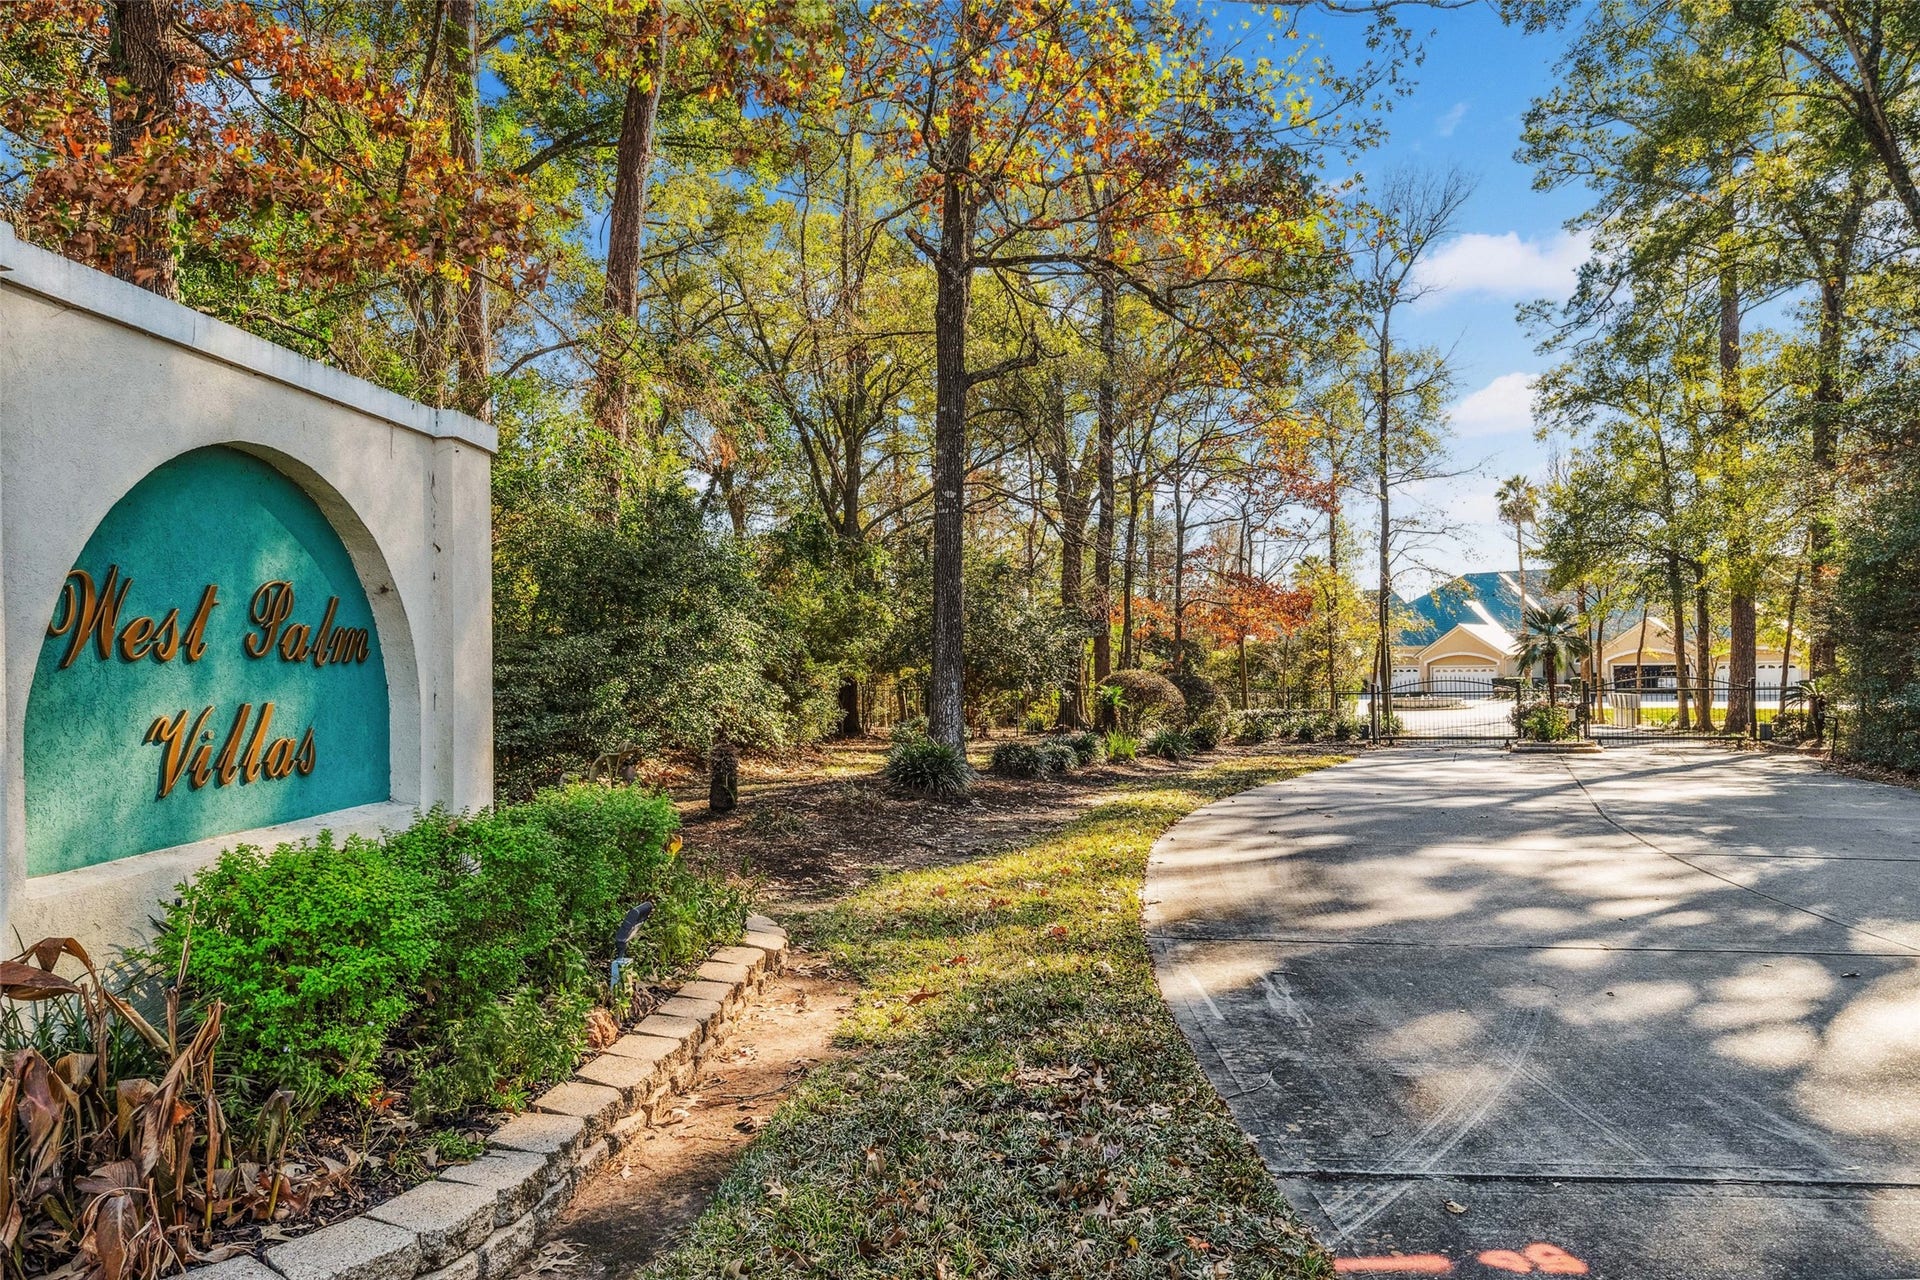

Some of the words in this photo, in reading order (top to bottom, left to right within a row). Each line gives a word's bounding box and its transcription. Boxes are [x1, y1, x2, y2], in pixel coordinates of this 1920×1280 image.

[47, 564, 219, 669] West
[245, 580, 371, 667] Palm
[143, 702, 317, 799] Villas
